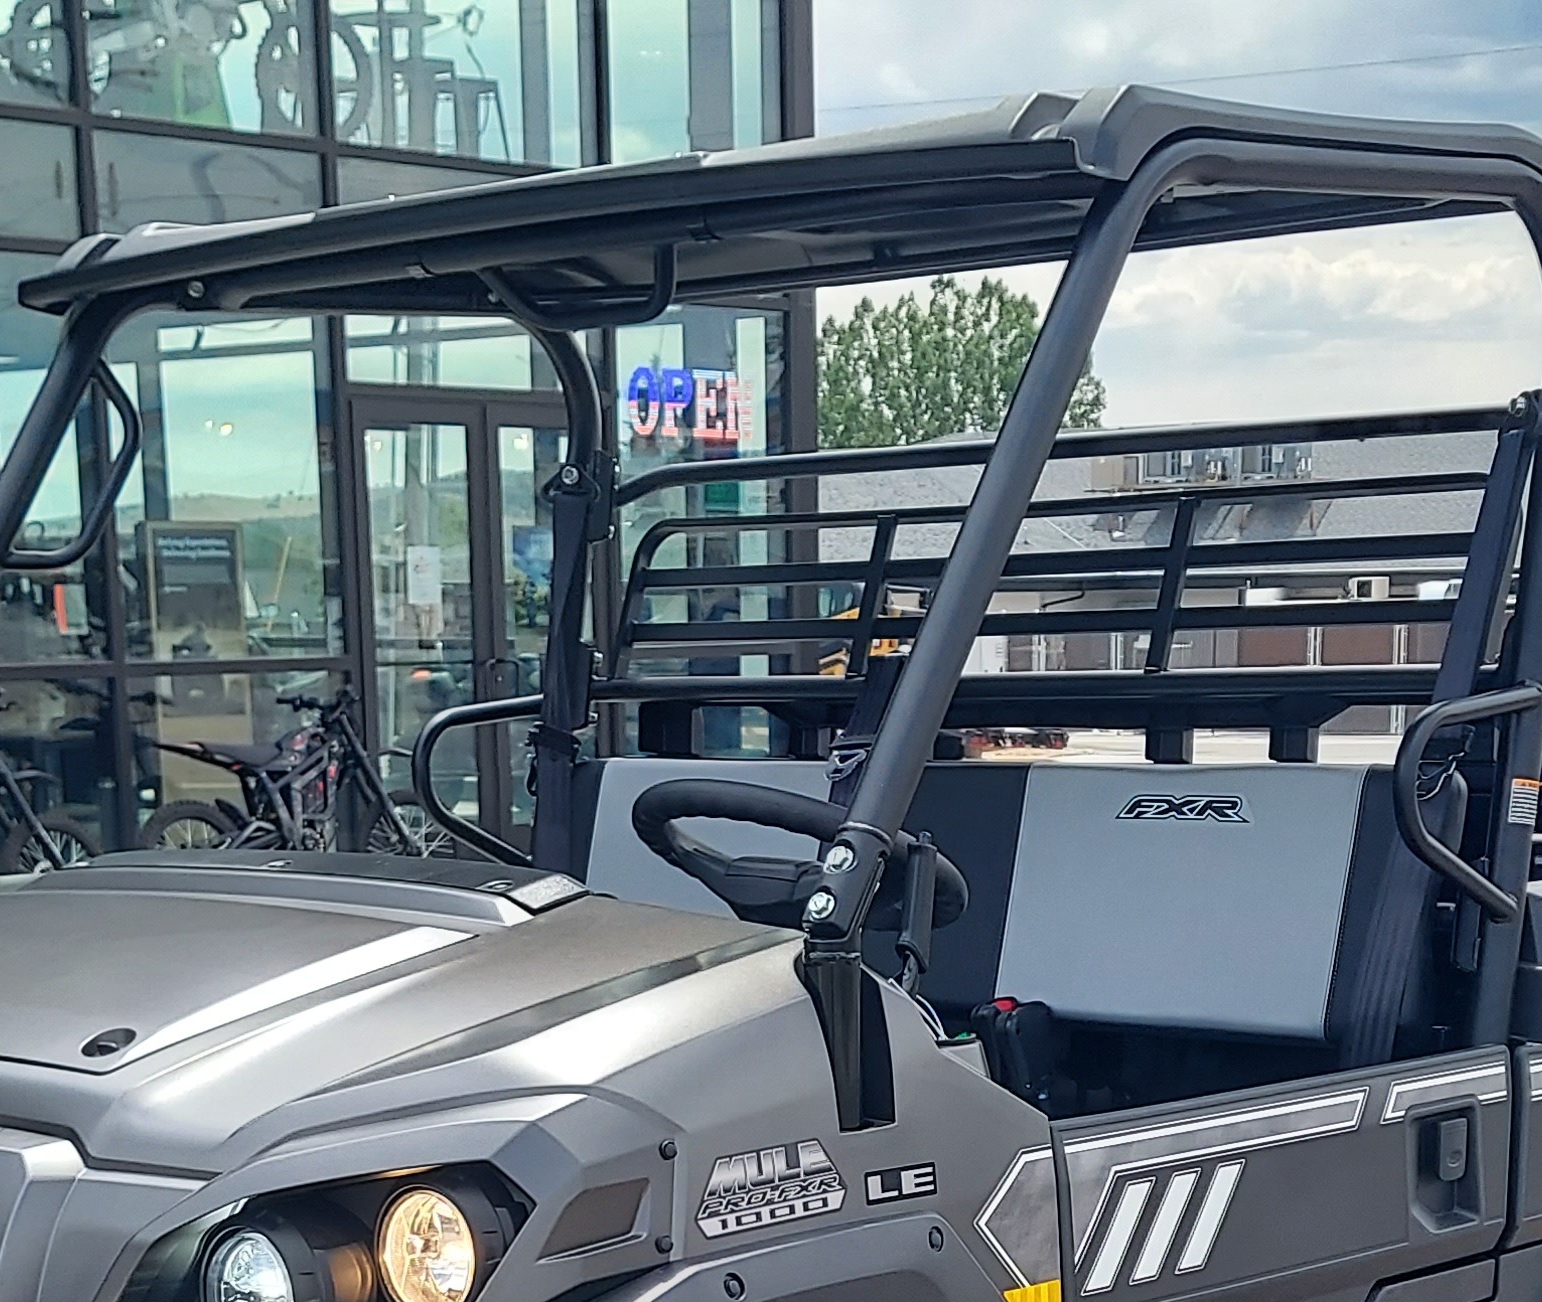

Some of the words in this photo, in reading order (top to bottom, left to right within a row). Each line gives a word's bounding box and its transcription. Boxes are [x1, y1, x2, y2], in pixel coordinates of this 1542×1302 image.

[627, 366, 753, 440] OPEN
[1115, 793, 1251, 824] FXR
[704, 1139, 836, 1200] MULE
[866, 1164, 937, 1203] LE
[718, 1196, 832, 1232] 1000
